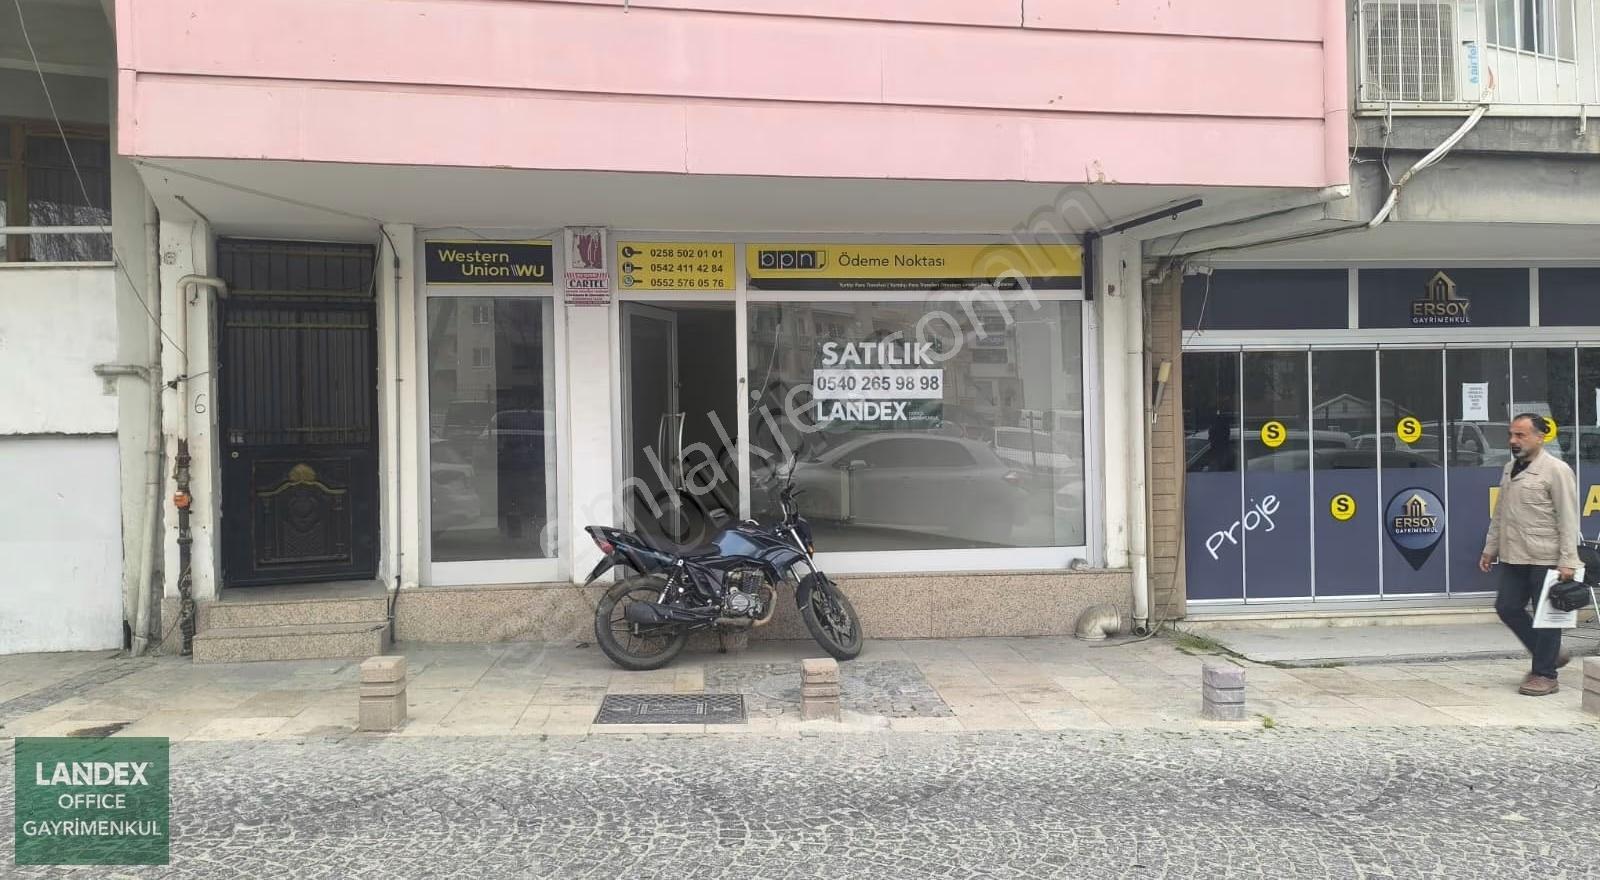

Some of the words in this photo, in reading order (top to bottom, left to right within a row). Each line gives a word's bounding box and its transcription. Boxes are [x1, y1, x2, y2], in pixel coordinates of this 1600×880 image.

[438, 249, 509, 262] Western
[650, 249, 674, 258] 0258
[677, 249, 695, 258] 502
[697, 249, 708, 258] 01
[711, 250, 723, 258] 01
[759, 251, 816, 269] bpn
[838, 251, 889, 267] Ödeme
[894, 252, 945, 267] Noktası
[461, 263, 510, 276] Union
[650, 264, 674, 272] 0542
[677, 264, 693, 272] 411
[697, 264, 709, 272] 42
[711, 264, 723, 273] 84
[569, 279, 605, 288] CARTEL
[650, 279, 674, 287] 0552
[677, 279, 695, 287] 576
[697, 279, 709, 287] 05
[712, 279, 724, 287] 76
[1412, 302, 1470, 316] ERSOY
[1412, 315, 1470, 324] GAYRİMENKUL
[821, 341, 935, 366] SATILIK
[817, 375, 856, 391] 0540
[861, 375, 891, 391] 265
[895, 375, 915, 391] 98
[919, 375, 940, 391] 98
[194, 393, 207, 414] 6
[817, 401, 908, 421] LANDEX
[1205, 493, 1281, 560] Proje
[1395, 517, 1438, 528] ERSOY
